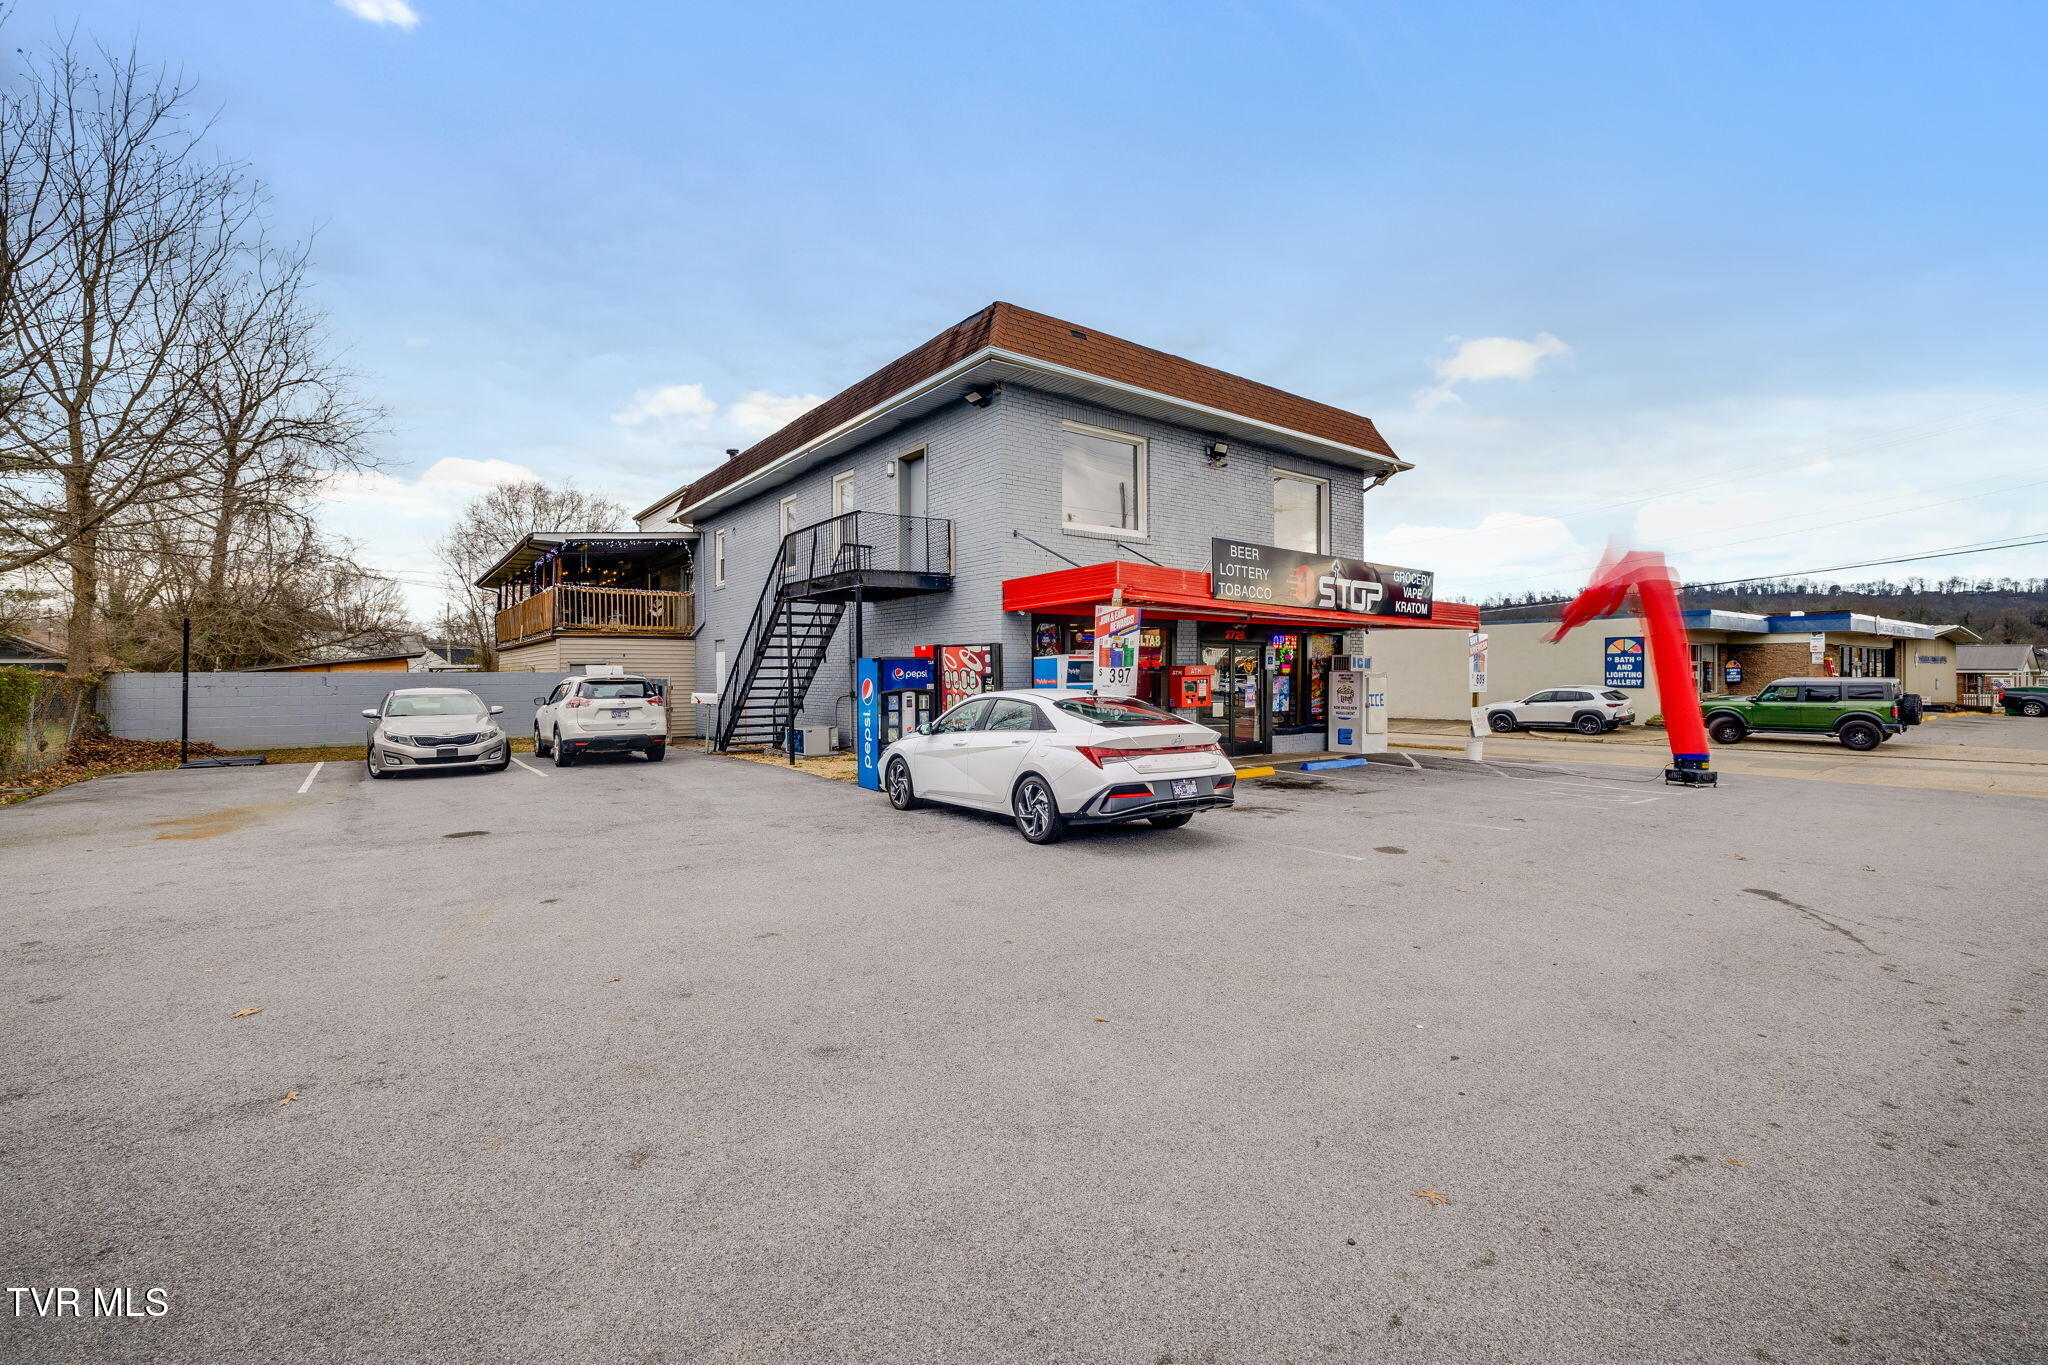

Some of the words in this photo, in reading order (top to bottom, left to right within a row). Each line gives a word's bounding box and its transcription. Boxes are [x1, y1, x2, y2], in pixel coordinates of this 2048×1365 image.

[1230, 545, 1260, 560] BEER
[1219, 562, 1270, 580] LOTTERY
[1393, 570, 1432, 587] GROCERY
[1217, 582, 1272, 600] TOBACCO
[1318, 575, 1383, 611] STOP
[1403, 586, 1423, 600] VAPE
[1395, 600, 1428, 615] KRATOM
[1139, 634, 1161, 647] LTA8
[1272, 635, 1298, 650] OPEN
[905, 669, 928, 679] pepsi
[1098, 668, 1103, 677] $
[1368, 693, 1385, 707] ICE
[862, 709, 873, 769] pepsi
